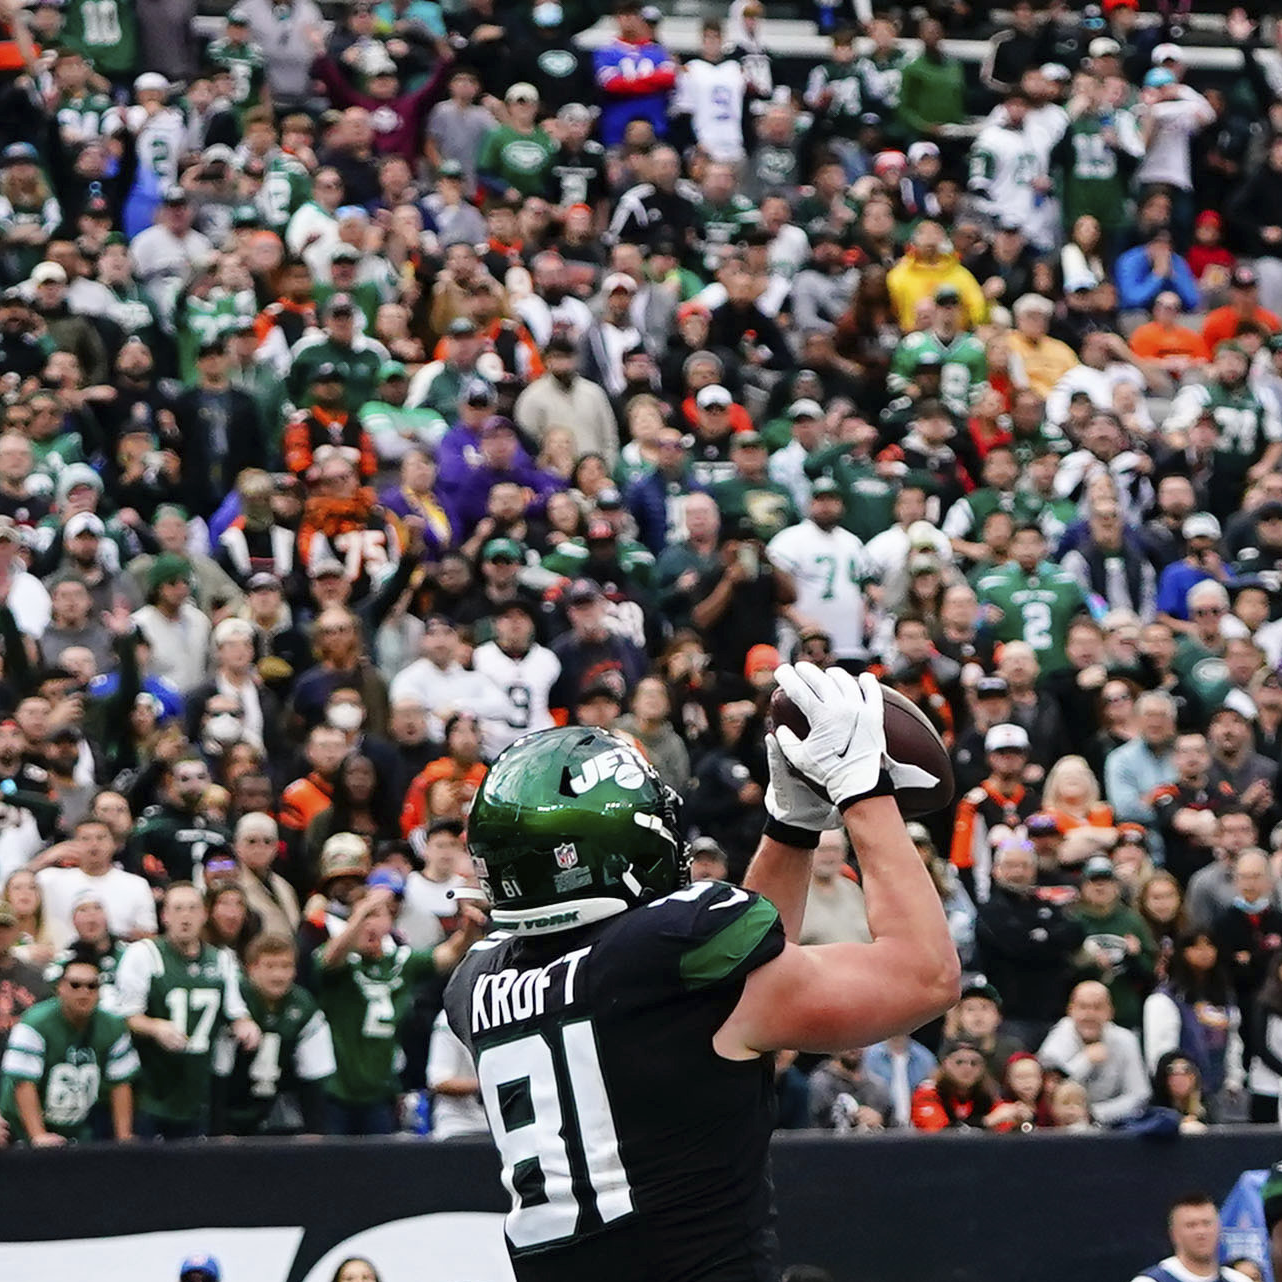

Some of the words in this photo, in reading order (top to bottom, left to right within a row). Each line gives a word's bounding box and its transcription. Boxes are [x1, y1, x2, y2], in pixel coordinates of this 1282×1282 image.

[1021, 601, 1054, 650] 2
[501, 879, 523, 898] 81
[523, 910, 580, 930] YORK
[471, 945, 593, 1034] KROFT
[164, 987, 222, 1054] 17
[477, 1018, 635, 1249] 81
